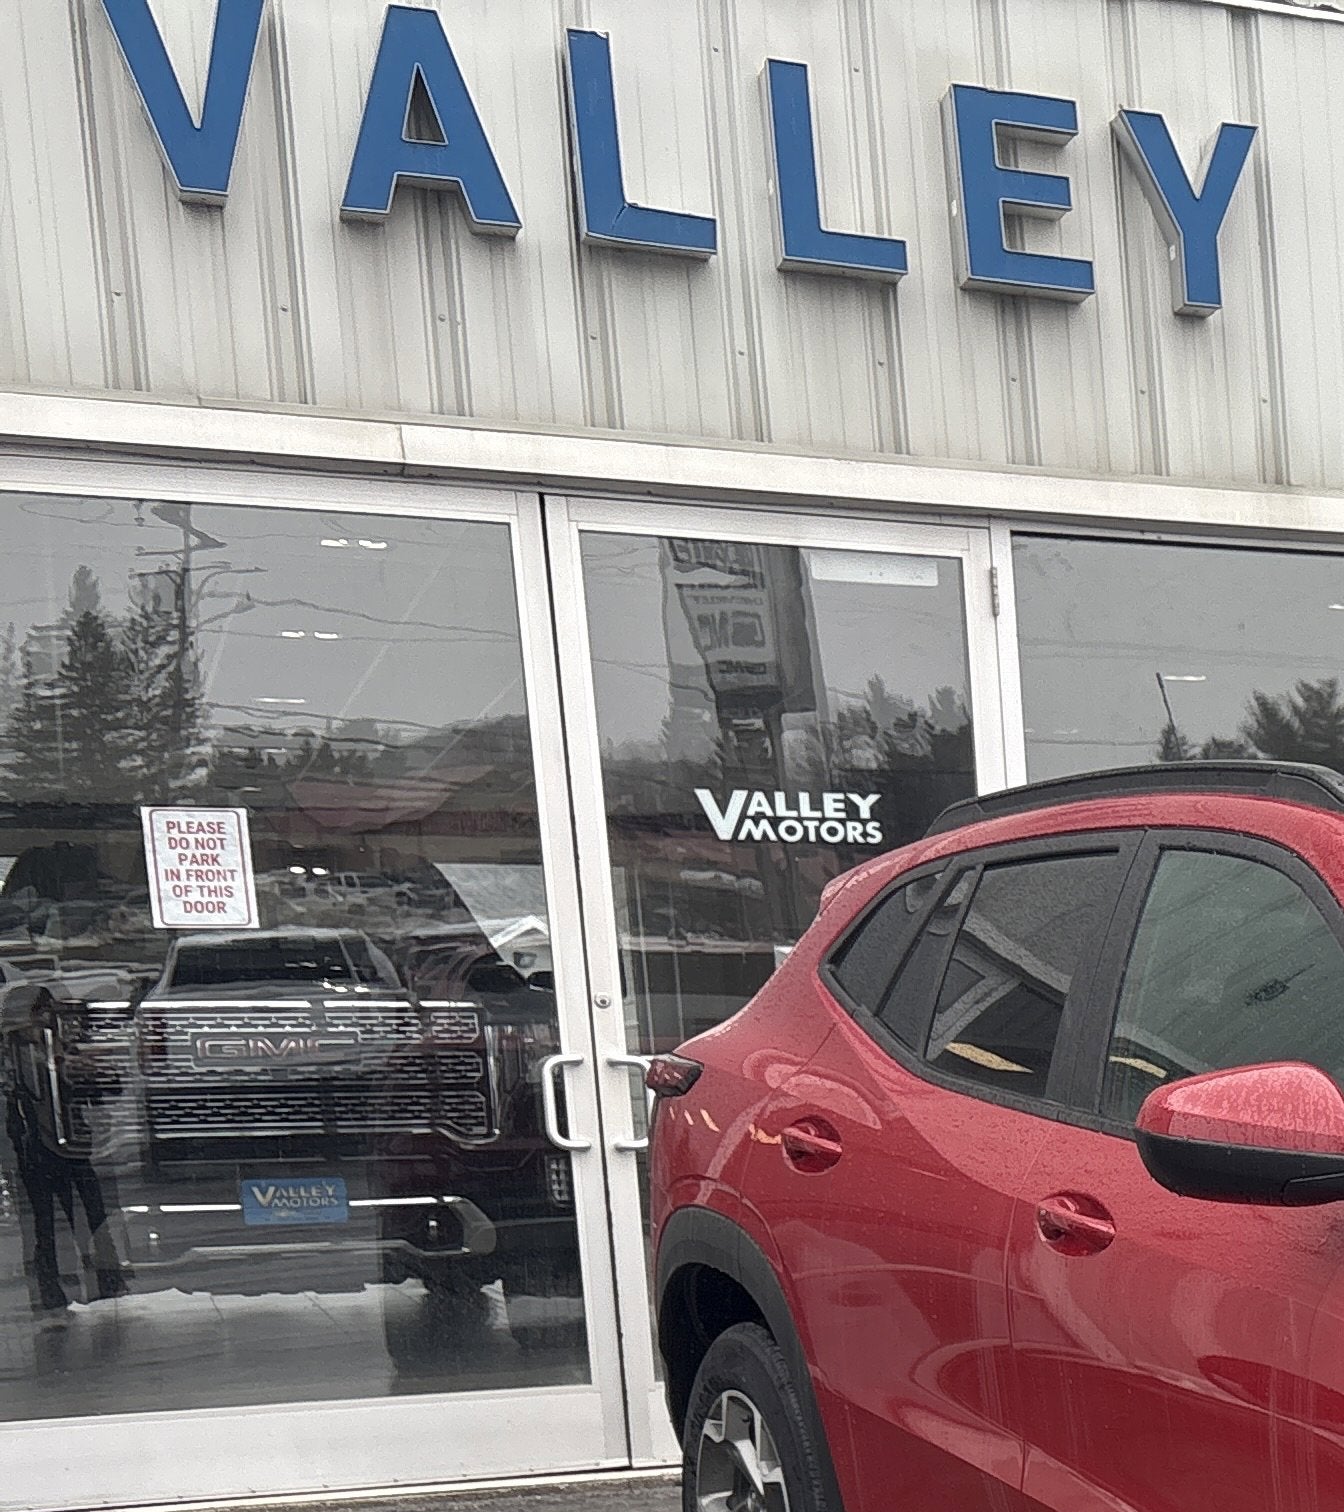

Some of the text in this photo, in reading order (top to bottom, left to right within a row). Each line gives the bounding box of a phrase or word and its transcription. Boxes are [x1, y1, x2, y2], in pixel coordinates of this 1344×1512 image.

[103, 0, 1257, 316] VALLEY
[694, 787, 882, 841] VALLEY
[165, 820, 227, 835] PLEASE
[738, 818, 883, 844] MOTORS
[168, 837, 227, 851] DO NOT
[178, 853, 222, 867] PARK
[164, 868, 238, 882] IN FRONT
[172, 885, 235, 898] OF THIS
[183, 901, 228, 914] DOOR
[196, 1037, 355, 1058] GMC
[252, 1184, 336, 1206] VALLEY
[271, 1196, 339, 1208] MOTORS
